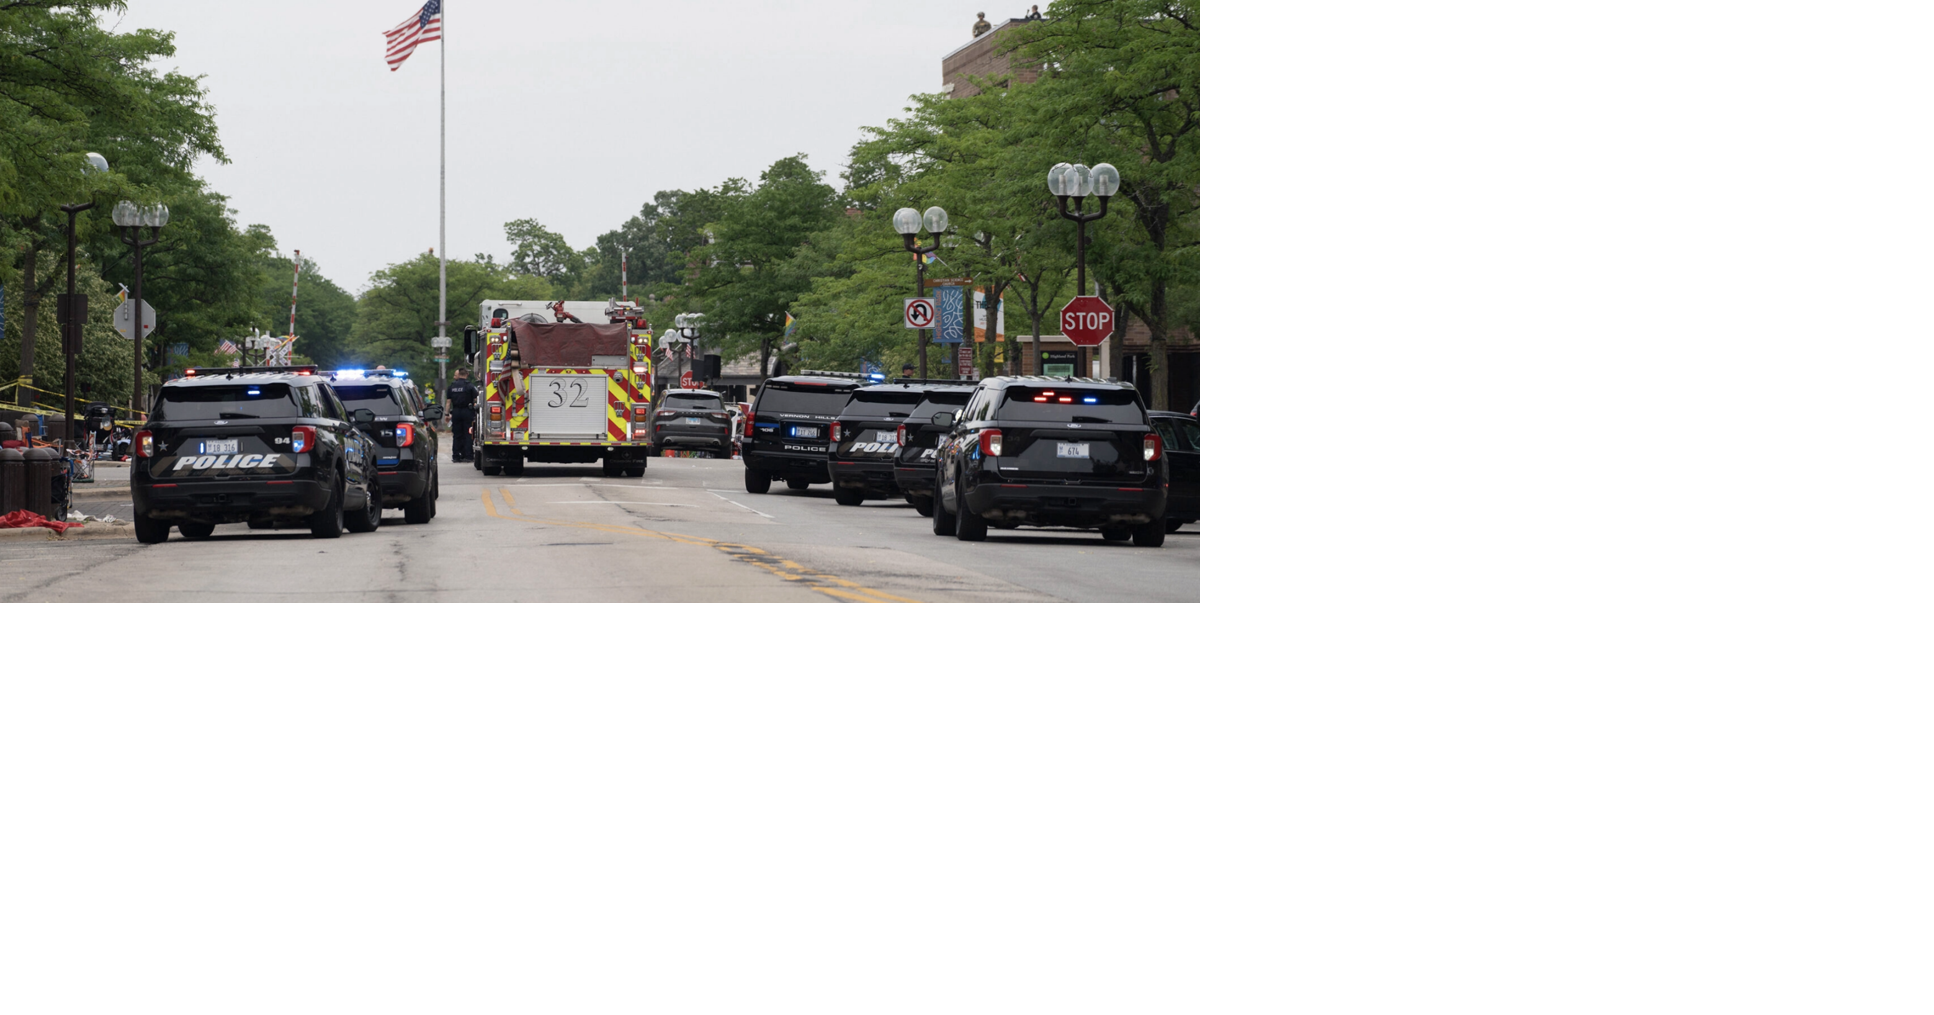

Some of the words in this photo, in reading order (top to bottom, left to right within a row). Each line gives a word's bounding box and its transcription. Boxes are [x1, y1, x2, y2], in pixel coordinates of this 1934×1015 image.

[1065, 312, 1110, 330] STOP
[682, 377, 698, 386] STO
[547, 377, 590, 408] 32
[274, 437, 291, 445] 94
[213, 444, 221, 453] 18
[224, 443, 236, 452] 316
[784, 444, 827, 452] POLICE
[849, 442, 899, 453] POLI
[1067, 446, 1080, 456] 674
[172, 453, 281, 471] POLICE
